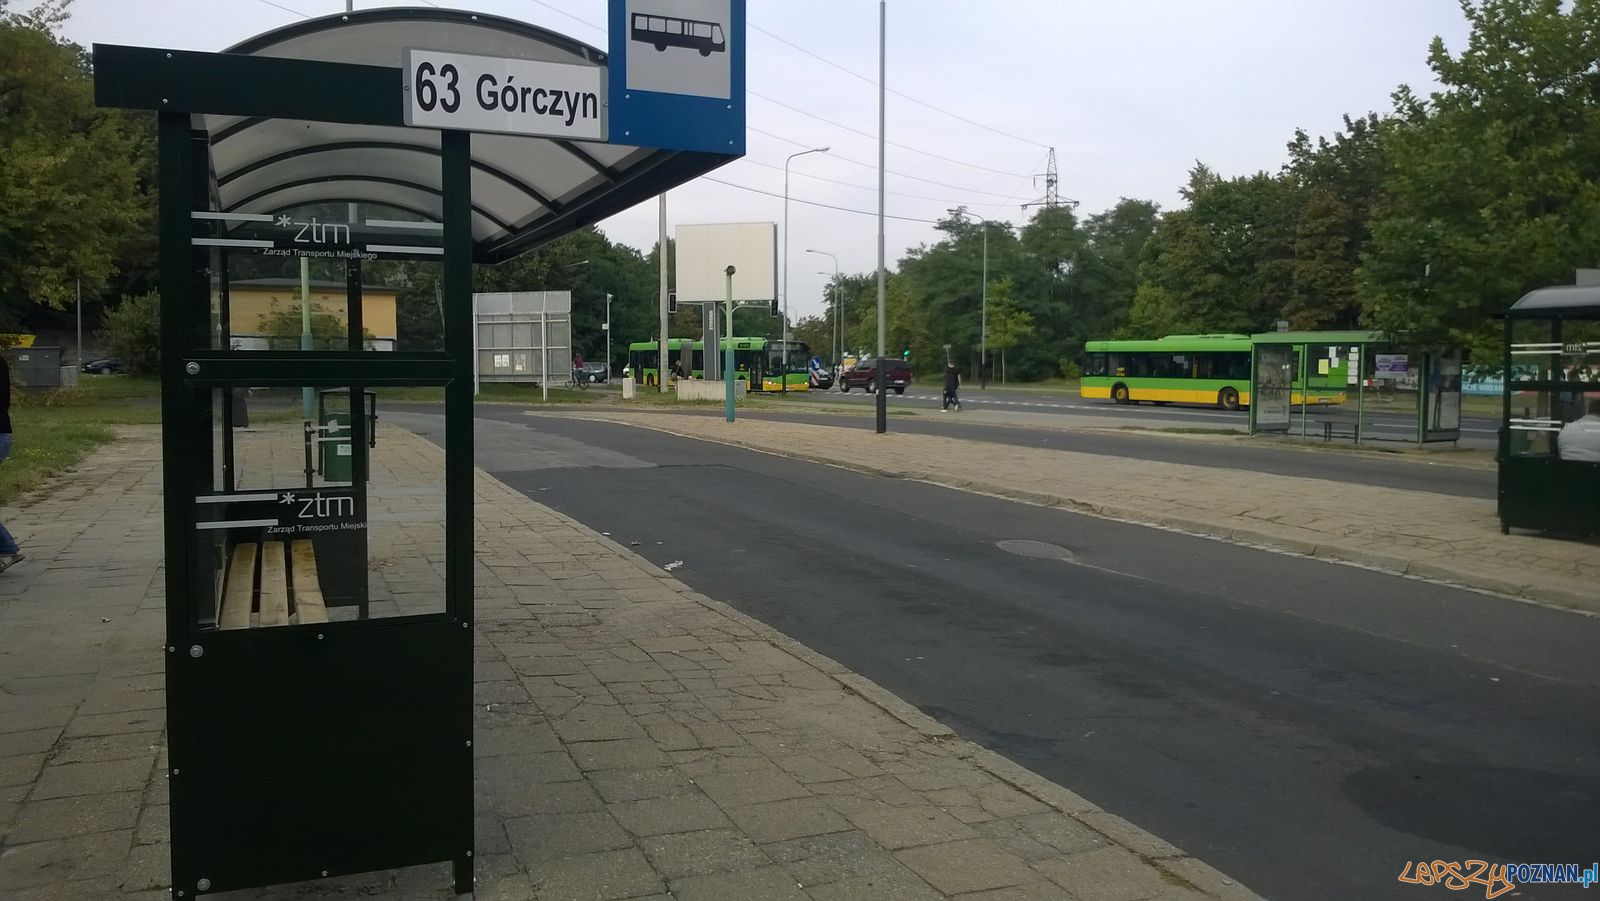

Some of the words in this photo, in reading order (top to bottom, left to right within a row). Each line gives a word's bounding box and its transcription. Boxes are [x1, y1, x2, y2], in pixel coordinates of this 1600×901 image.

[415, 61, 461, 114] 63
[475, 73, 598, 127] Górczyn
[262, 247, 291, 258] Zarząd
[292, 248, 335, 258] Transportu
[336, 250, 378, 261] Miejskiego
[267, 524, 295, 534] Zarząd
[297, 522, 339, 533] Transportu
